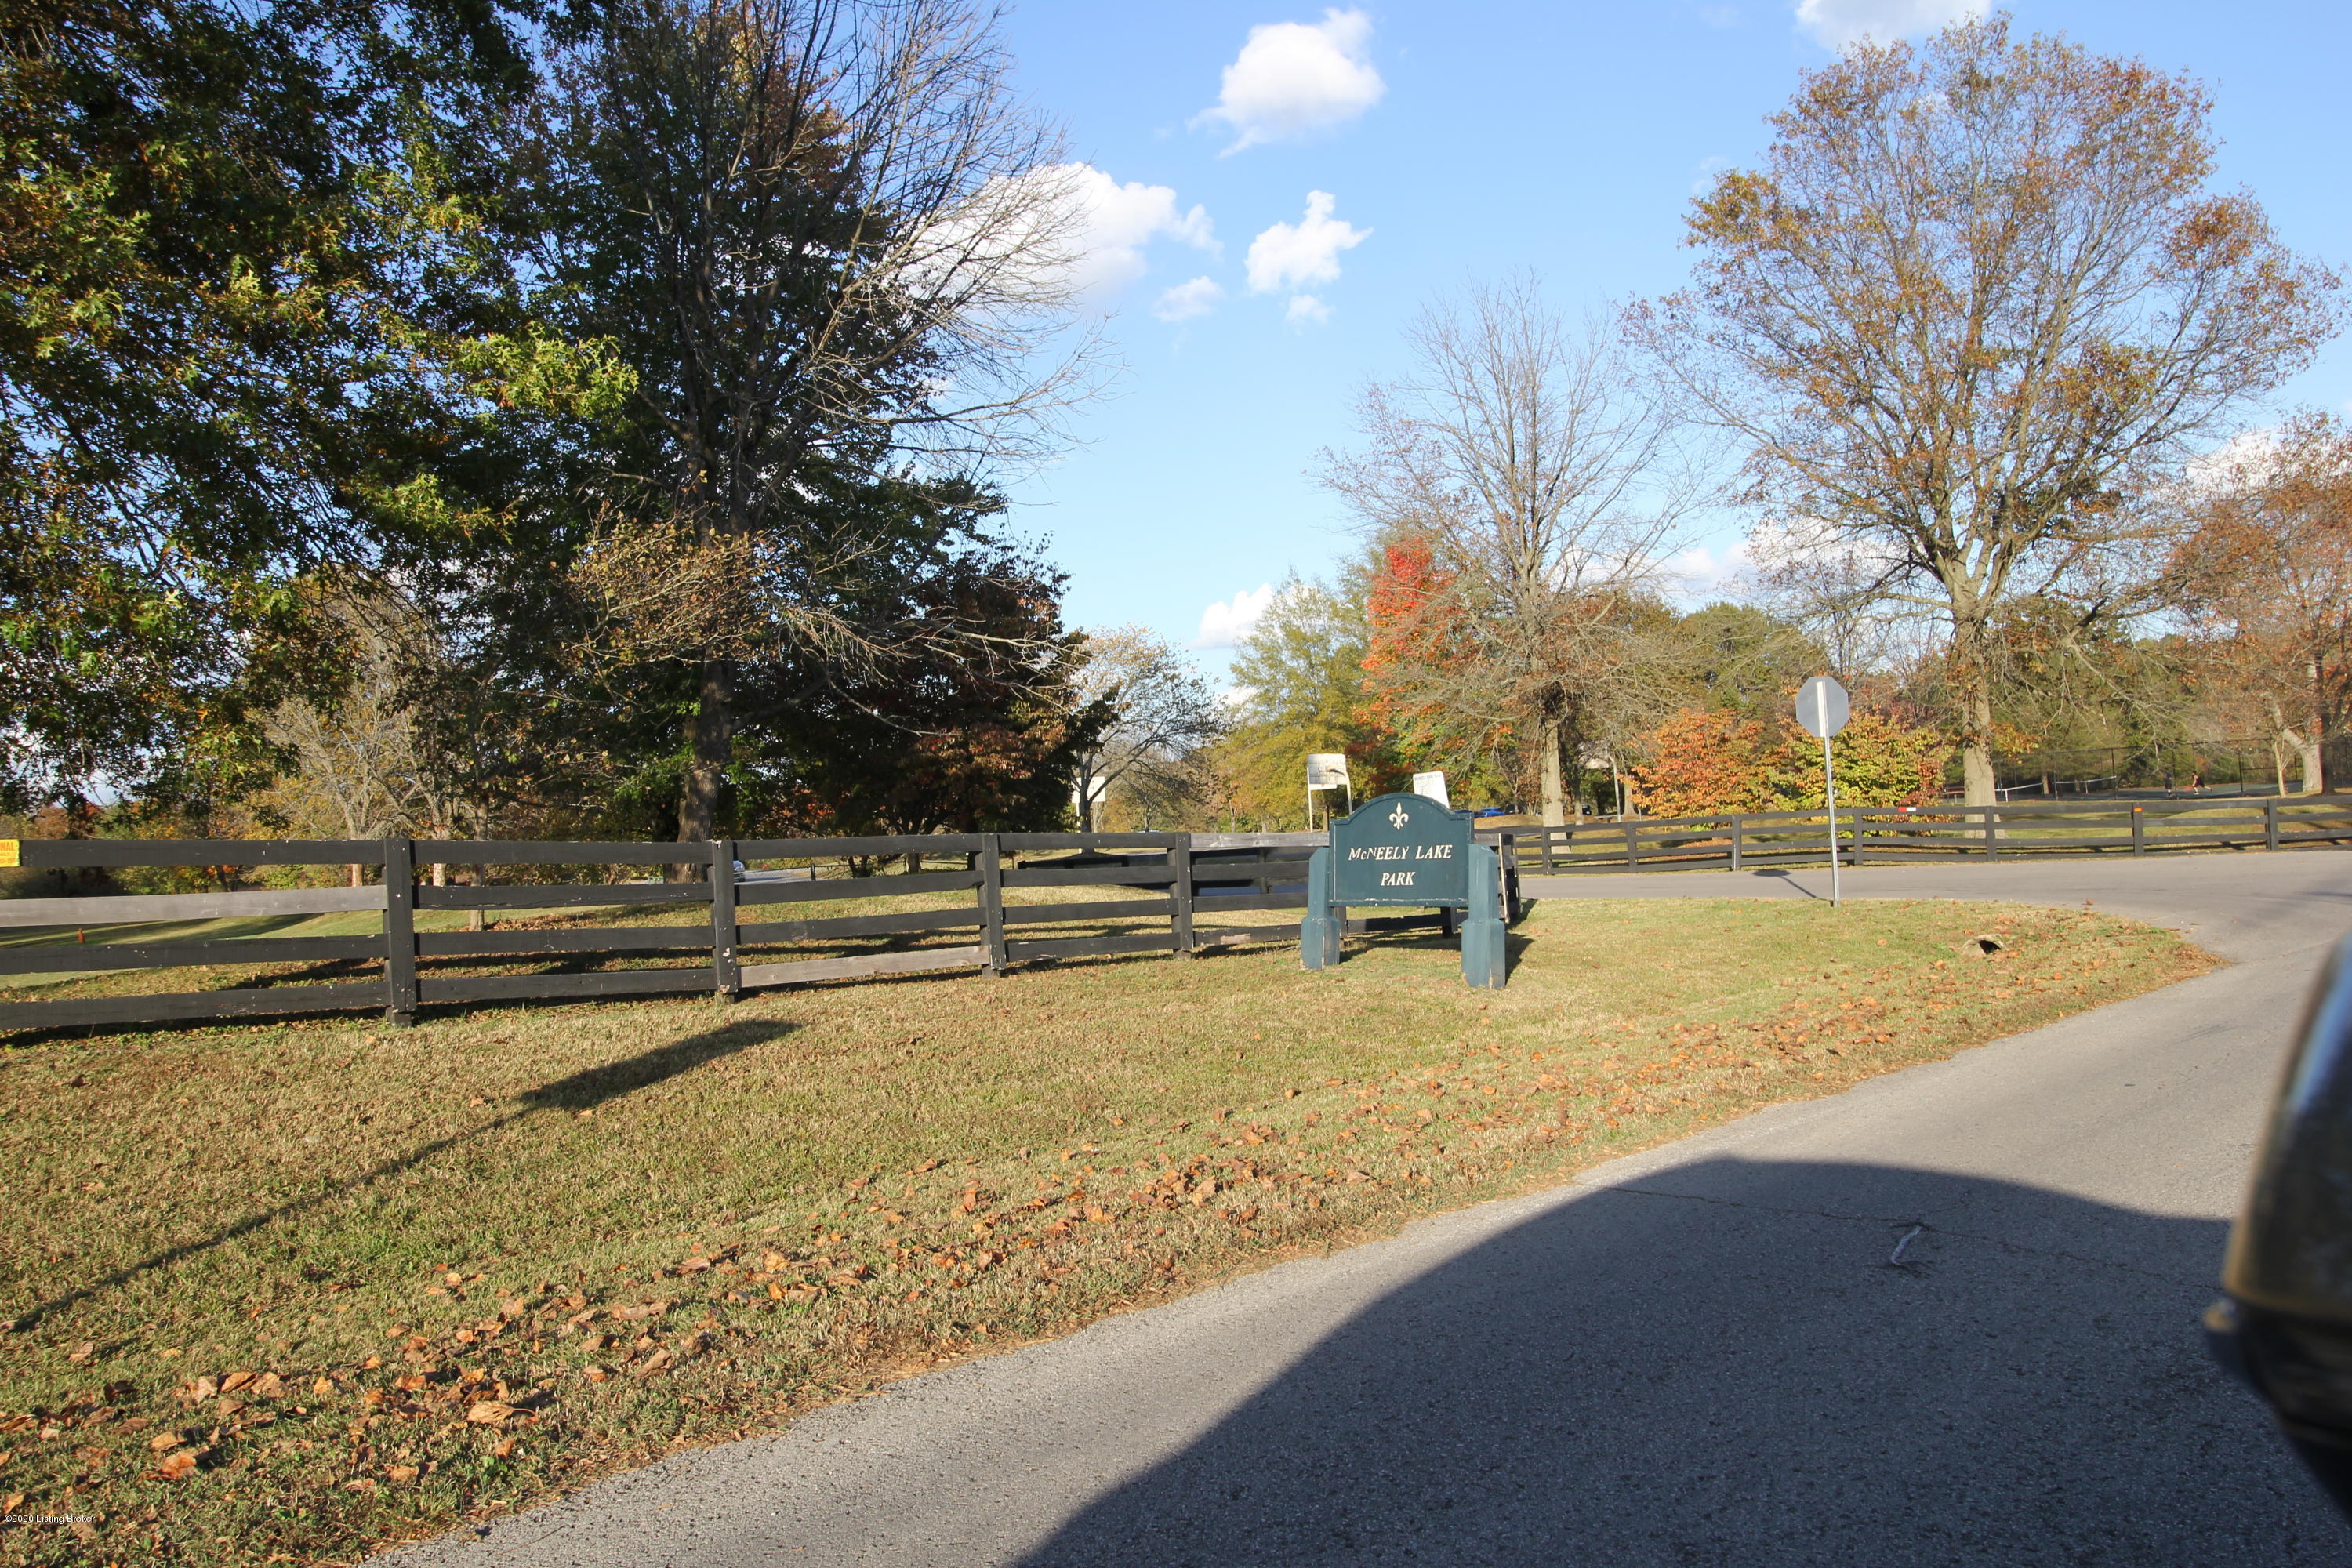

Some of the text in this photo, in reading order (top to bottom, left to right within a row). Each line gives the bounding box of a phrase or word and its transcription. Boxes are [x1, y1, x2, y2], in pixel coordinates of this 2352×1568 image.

[0, 841, 15, 851] NAL
[1348, 844, 1453, 861] McNEELY LAKE
[1380, 871, 1416, 886] PARK
